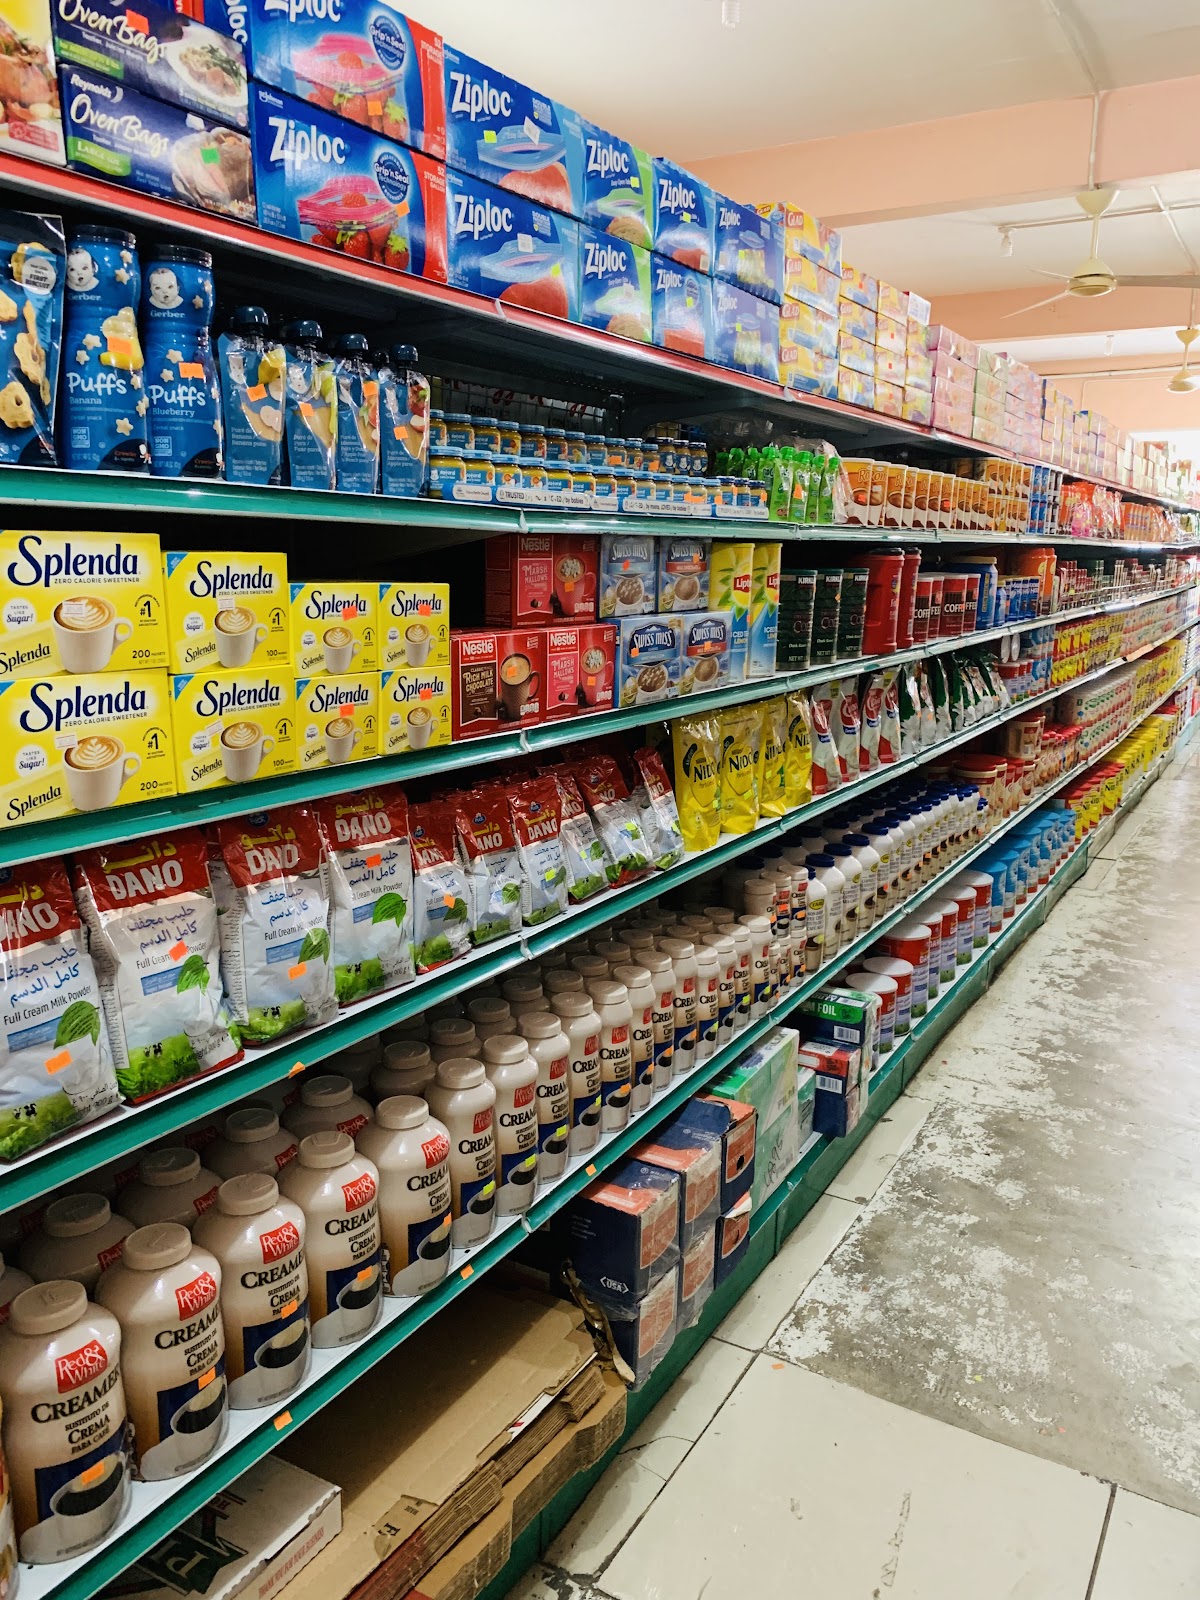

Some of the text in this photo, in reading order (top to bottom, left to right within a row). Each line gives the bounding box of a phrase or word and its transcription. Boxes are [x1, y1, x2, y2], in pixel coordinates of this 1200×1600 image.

[70, 74, 112, 100] Reynolds
[450, 71, 512, 122] Ziploc
[70, 94, 126, 132] Oven
[123, 115, 169, 158] Bags
[269, 116, 346, 170] Ziploc
[586, 139, 629, 178] Ziploc
[393, 171, 409, 185] Seal
[424, 172, 445, 187] STORAGE
[437, 166, 445, 177] 52
[659, 179, 695, 214] Ziploc
[454, 194, 513, 240] Ziploc
[719, 207, 741, 229] Ziploc
[788, 213, 804, 226] GLAD
[584, 243, 626, 279] Ziploc
[787, 259, 802, 272] GLAD
[657, 269, 682, 295] Ziploc
[67, 293, 101, 301] Gerber
[718, 295, 737, 313] Ziploc
[150, 311, 185, 319] Gerber
[782, 304, 799, 318] GLAD
[782, 348, 798, 363] GLAD
[67, 372, 127, 395] Puffs
[70, 397, 102, 405] Banana
[151, 384, 206, 407] Puffs
[152, 407, 195, 417] Blueberry
[7, 535, 138, 587] Splenda
[522, 563, 547, 575] MARSH
[189, 561, 273, 598] Splenda
[524, 574, 547, 585] MALLOWS
[140, 600, 152, 617] #1
[305, 590, 366, 619] Splenda
[391, 590, 441, 618] Splenda
[6, 613, 34, 625] Sugar!
[186, 623, 204, 631] Sugar!
[272, 612, 280, 626] #1
[633, 630, 672, 648] SWISS MISS
[692, 625, 725, 643] SWISS MISS
[0, 643, 50, 675] Splenda
[132, 650, 150, 658] 200
[185, 642, 216, 664] Splenda
[302, 654, 324, 670] Splenda
[551, 658, 574, 671] MARSH
[554, 667, 574, 679] MALLOWS
[480, 671, 493, 680] MILK
[393, 676, 443, 702] Splenda
[466, 678, 493, 692] CHOCOLATE
[19, 681, 146, 732] Splenda
[196, 679, 280, 717] Splenda
[310, 684, 368, 712] Splenda
[84, 717, 111, 725] CALORIE
[112, 712, 148, 721] SWEETENER
[279, 722, 287, 736] #1
[148, 733, 159, 750] #1
[191, 740, 210, 750] Sugar!
[19, 757, 45, 770] Sugar!
[191, 759, 222, 781] Splenda
[140, 780, 158, 791] 200
[7, 785, 61, 821] Splenda
[335, 812, 391, 842] DANO
[527, 819, 558, 841] DANO
[106, 860, 183, 900] DANO
[371, 885, 382, 895] Milk
[383, 881, 403, 893] Powder
[165, 906, 195, 921] حليب
[140, 921, 197, 955] كامل الدسم
[264, 924, 296, 941] Full Cream
[42, 945, 78, 968] حليب
[136, 957, 150, 969] Full
[10, 962, 79, 1007] كامل الدسم
[3, 985, 91, 1026] Full Cream Milk Powder
[817, 1003, 836, 1016] FOIL
[350, 1233, 376, 1254] CREMA
[353, 1250, 366, 1261] PARA
[268, 1280, 293, 1297] SUSTITUTO
[606, 1280, 622, 1292] USA
[270, 1287, 301, 1308] CREMA
[184, 1328, 217, 1355] SUSTITUTO DE
[187, 1341, 218, 1367] CREMA
[189, 1361, 206, 1376] PARA
[31, 1366, 120, 1424] CREAMER
[65, 1401, 109, 1431] SUSTITUTO DE
[67, 1414, 110, 1445] CREMA
[71, 1438, 92, 1454] PARA
